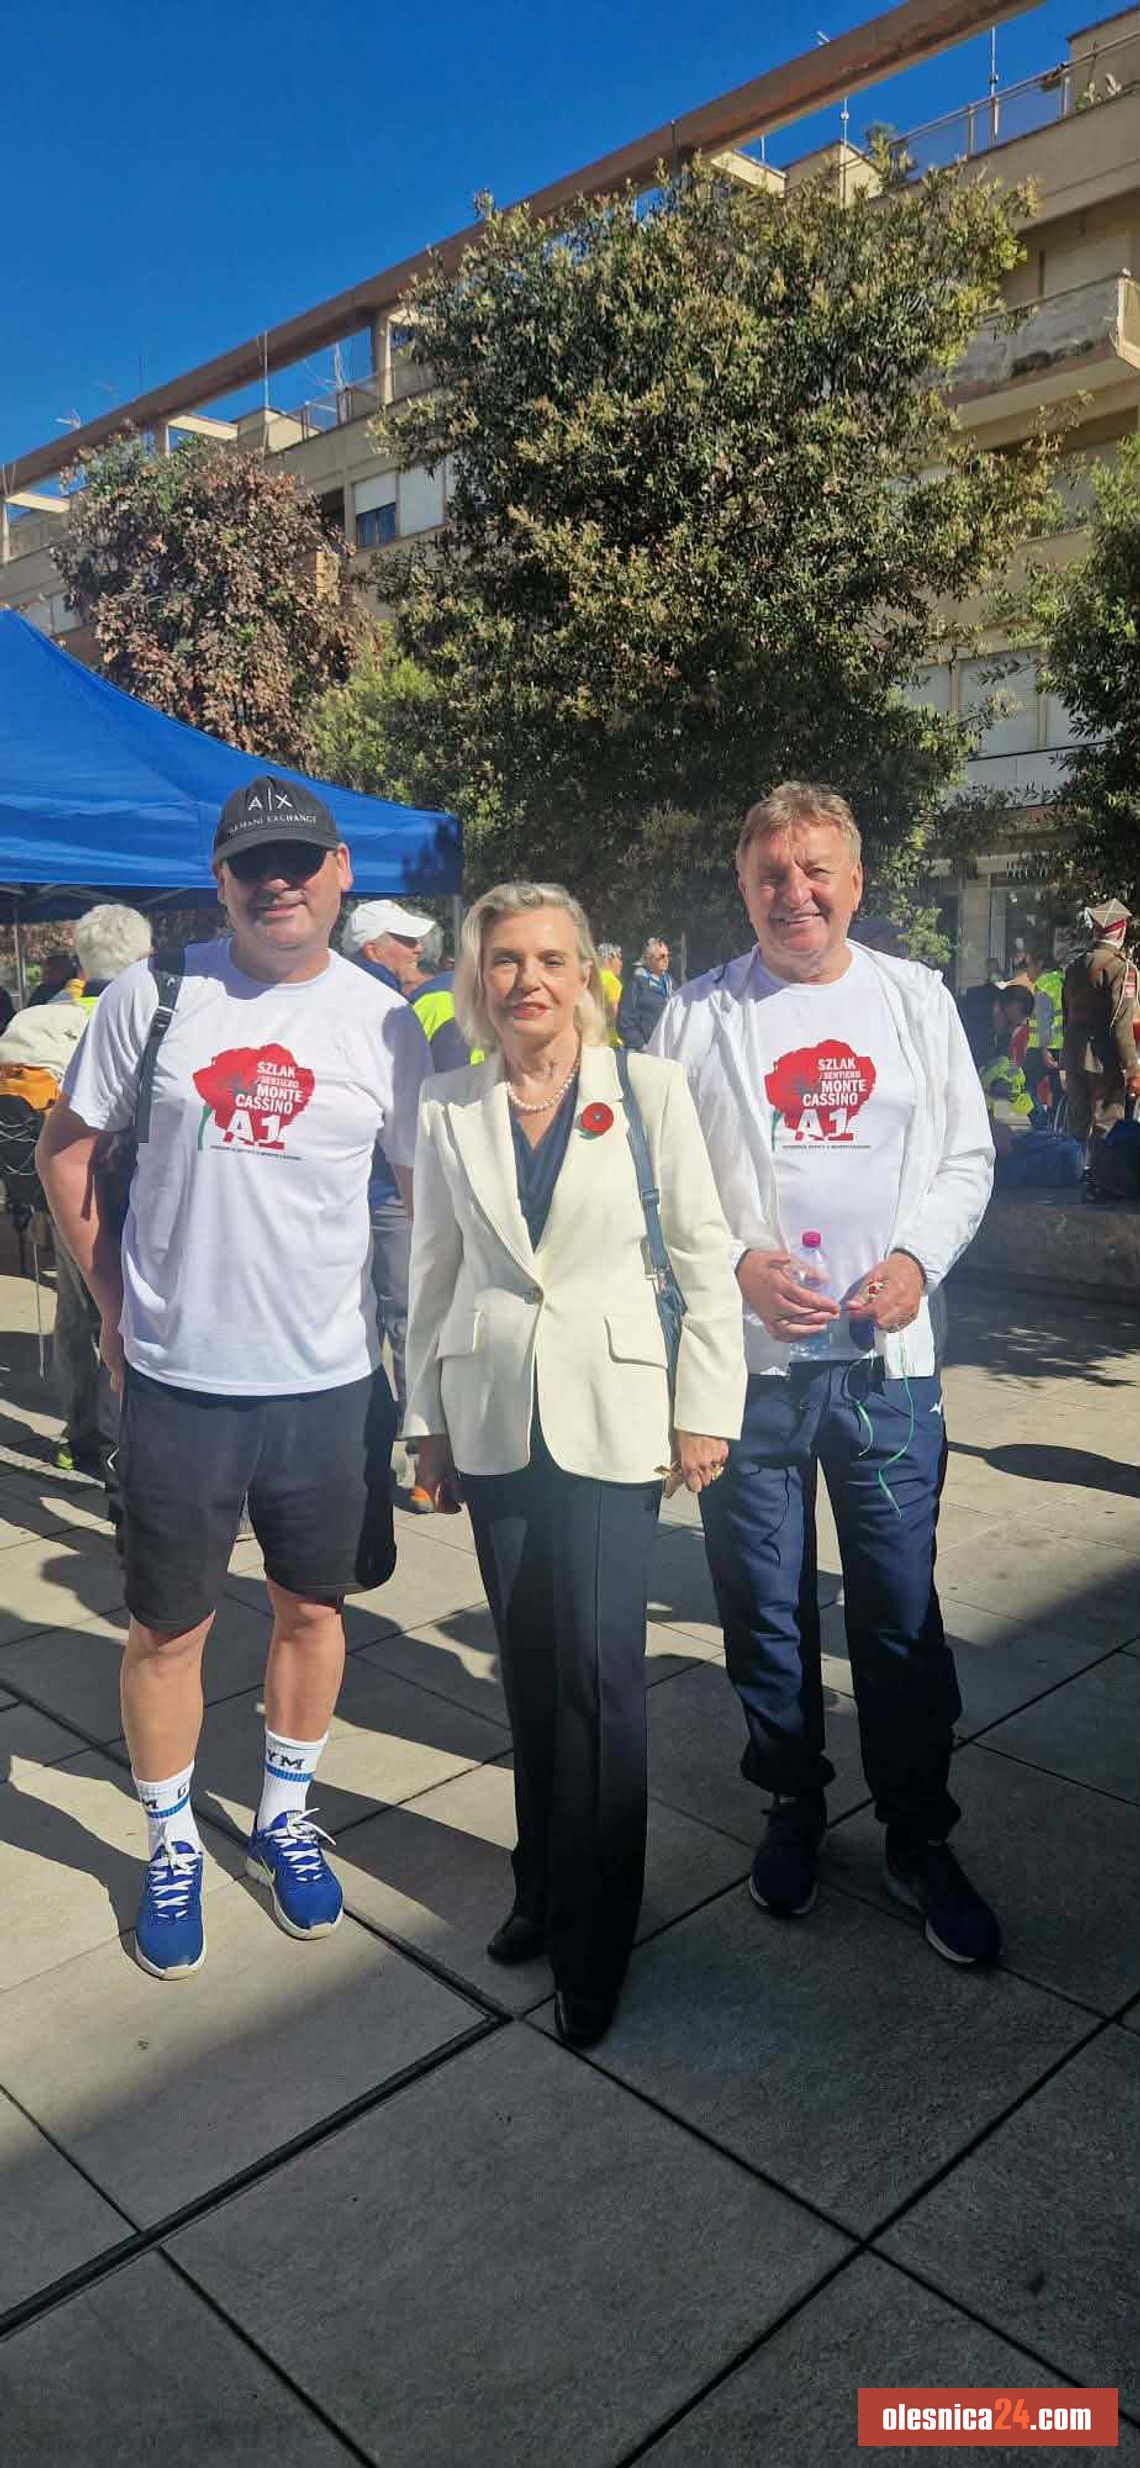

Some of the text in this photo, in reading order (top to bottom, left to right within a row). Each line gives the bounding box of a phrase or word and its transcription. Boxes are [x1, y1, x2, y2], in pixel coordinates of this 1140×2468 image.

[267, 813, 317, 825] EXCHANGE
[256, 1061, 296, 1078] SZLAK
[818, 1058, 857, 1070] SZLAK
[256, 1084, 304, 1103] MONTE
[821, 1079, 868, 1093] MONTE
[235, 1093, 294, 1114] CASSINO
[803, 1092, 858, 1107] CASSINO
[223, 1109, 285, 1151] A1
[794, 1107, 854, 1141] A1
